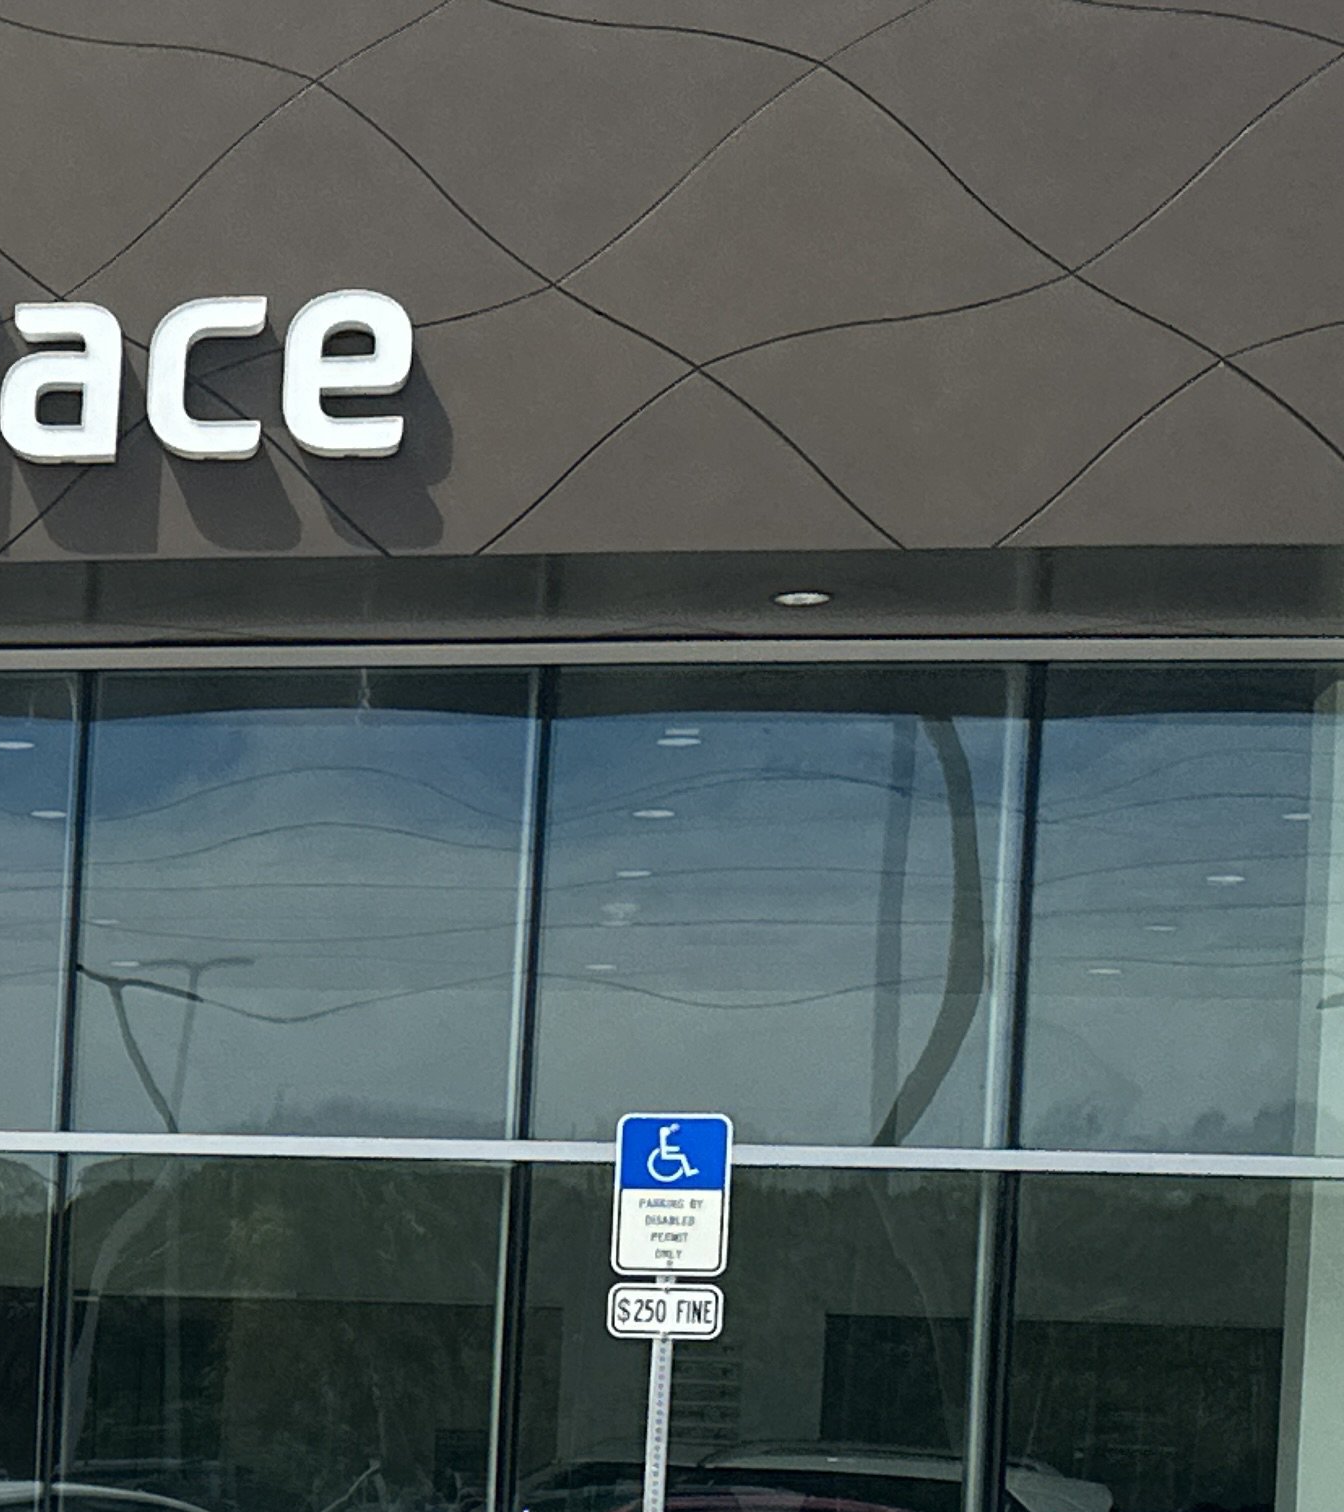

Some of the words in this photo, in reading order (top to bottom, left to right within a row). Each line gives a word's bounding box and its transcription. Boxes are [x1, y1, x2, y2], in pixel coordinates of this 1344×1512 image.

[638, 1198, 685, 1209] PARKING
[689, 1198, 704, 1209] BY
[645, 1214, 696, 1226] DISABLED
[650, 1232, 688, 1242] PERMIT
[654, 1249, 683, 1259] ONLY
[675, 1301, 712, 1324] FINE
